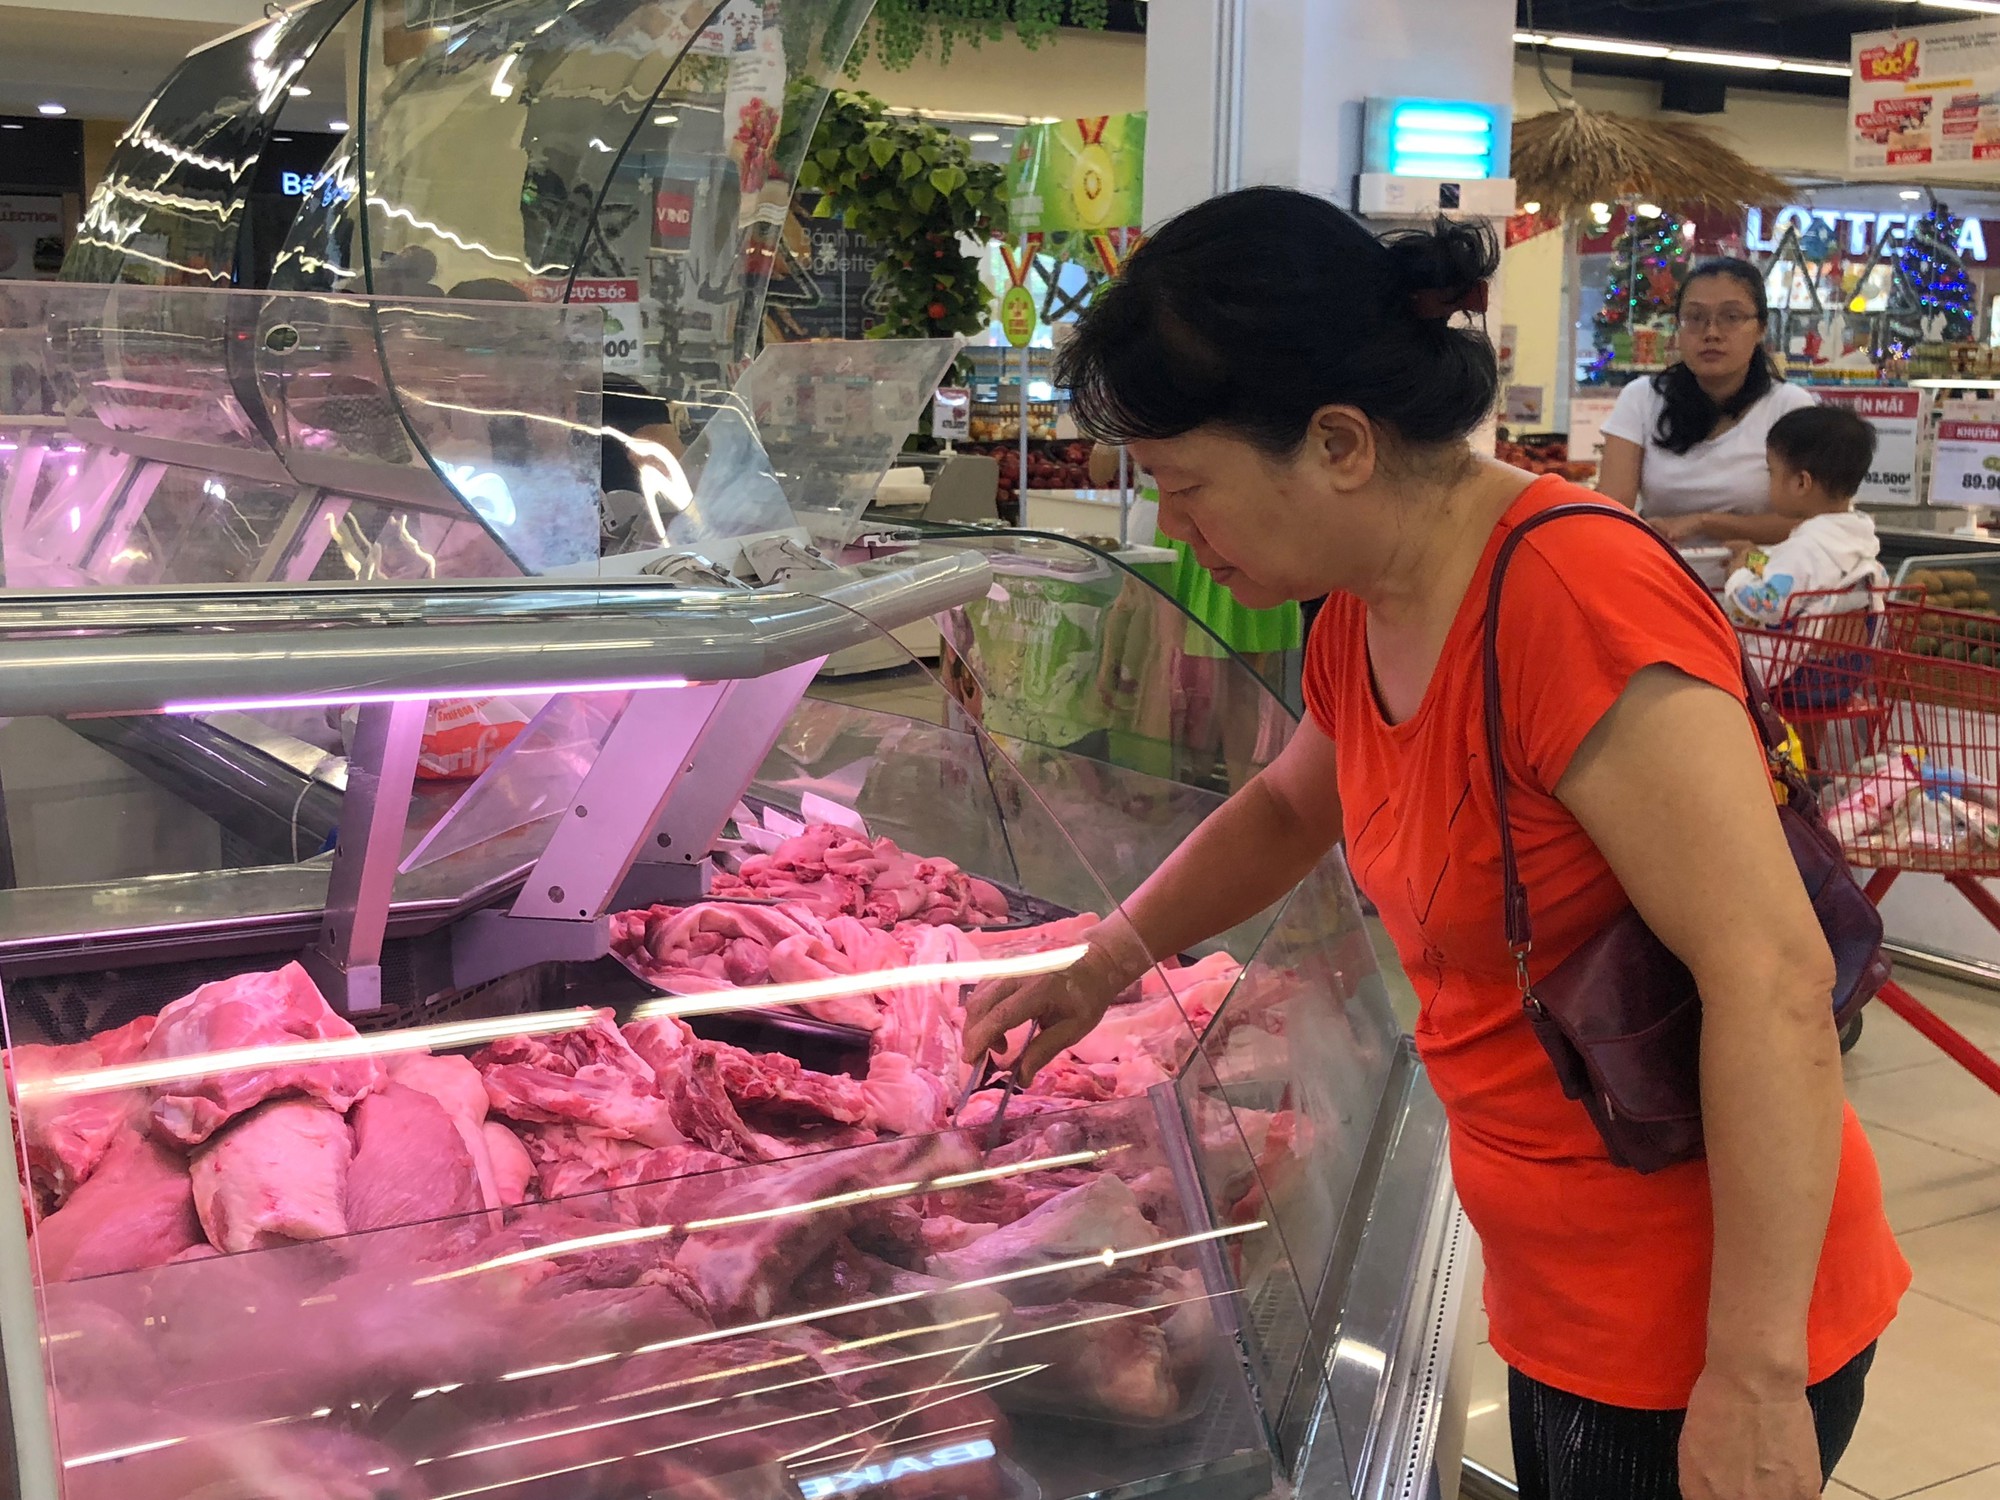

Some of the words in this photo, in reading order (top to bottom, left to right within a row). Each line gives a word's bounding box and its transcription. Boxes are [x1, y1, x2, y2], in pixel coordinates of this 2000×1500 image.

[0, 211, 58, 223] LECTION
[1745, 204, 1988, 262] LOTTEA
[801, 253, 878, 276] aguette
